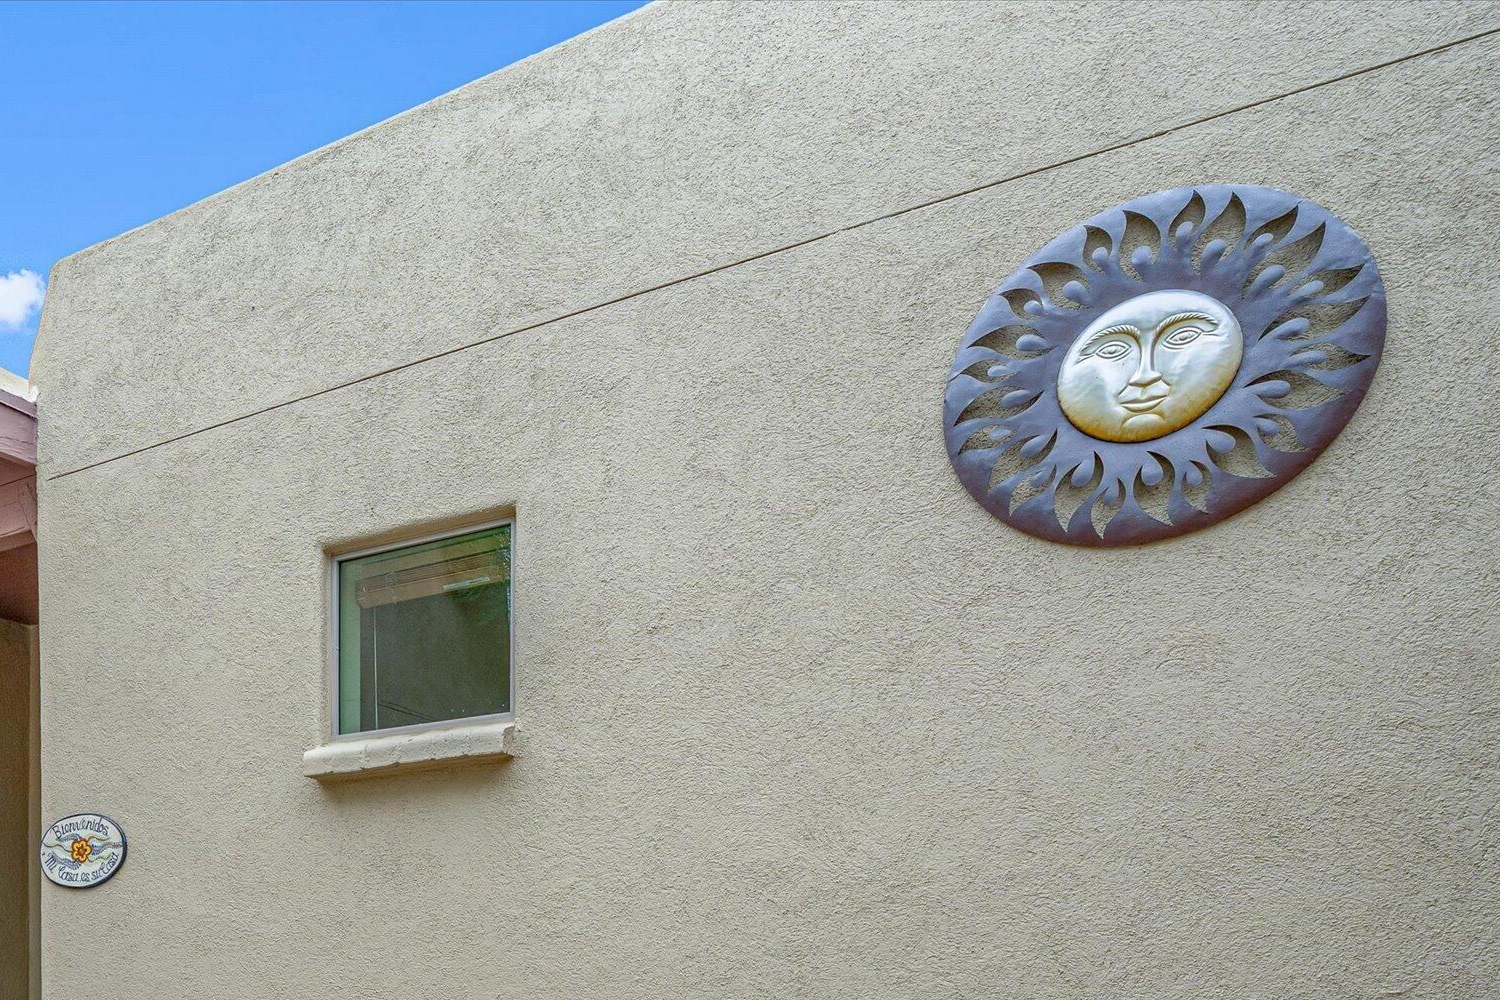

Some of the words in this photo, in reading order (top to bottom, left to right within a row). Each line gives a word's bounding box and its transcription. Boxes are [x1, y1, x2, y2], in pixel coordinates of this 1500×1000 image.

[52, 817, 109, 839] Bienvenidos
[80, 872, 91, 882] es
[91, 869, 102, 880] su
